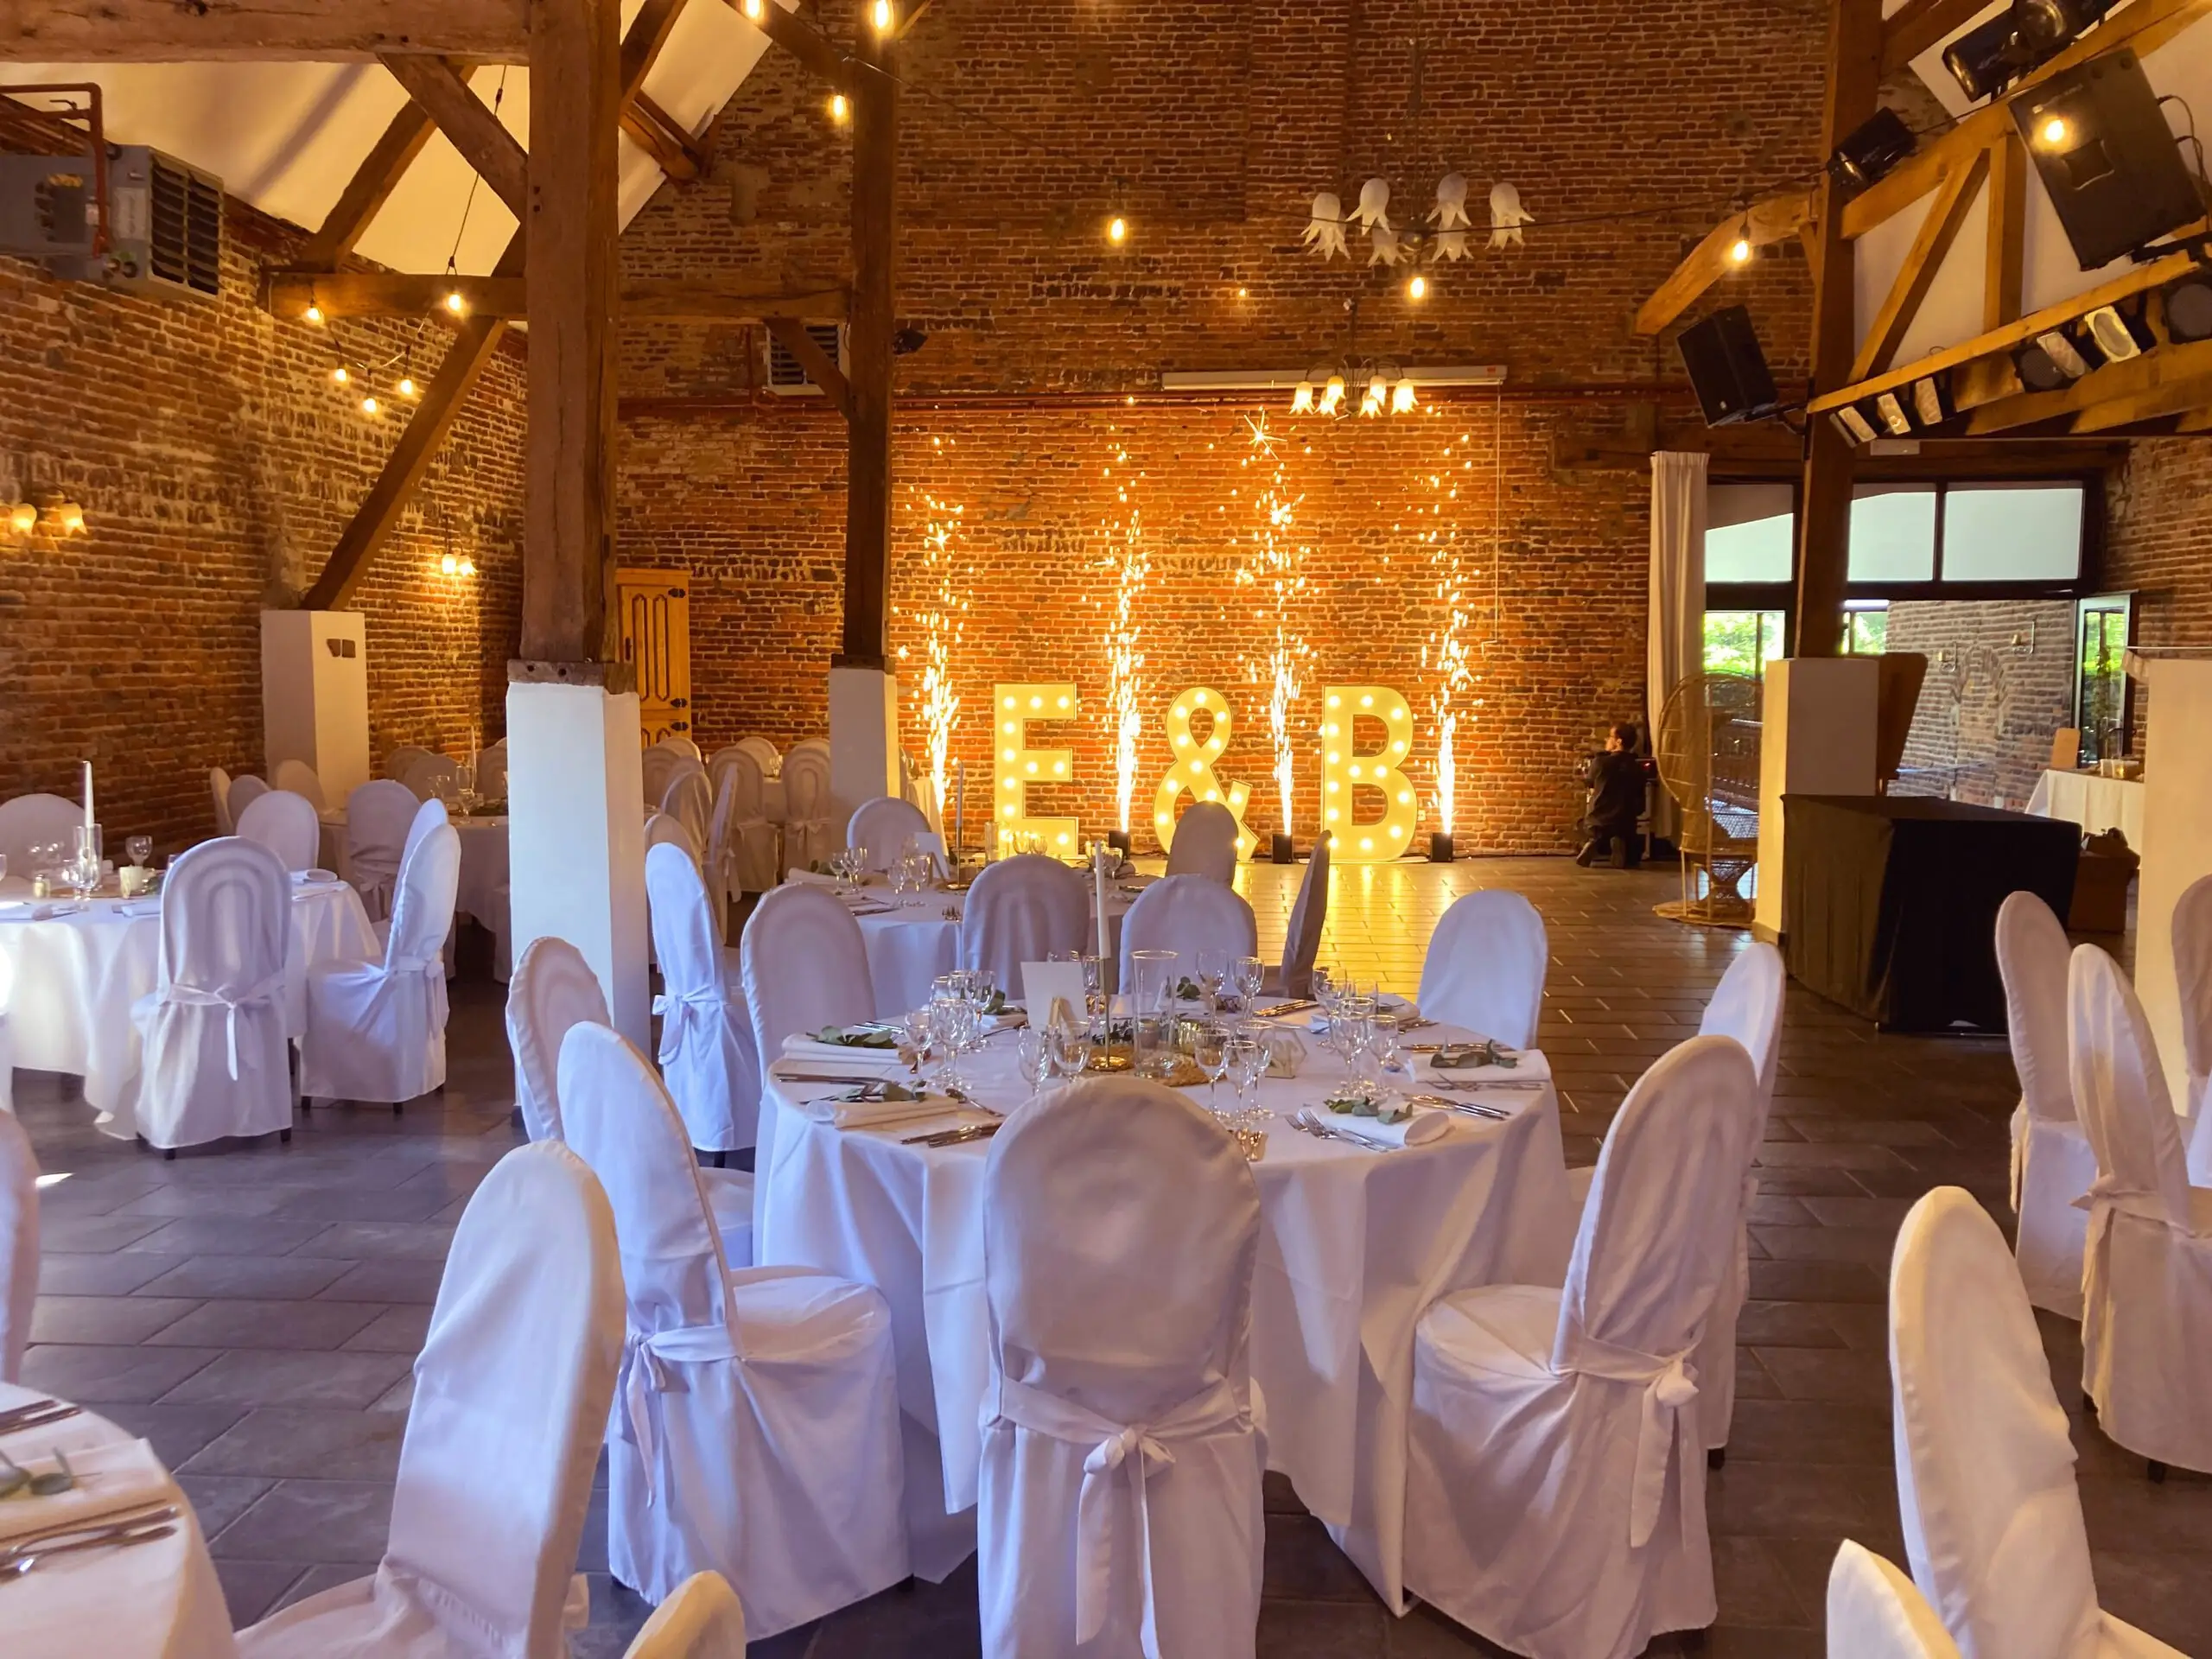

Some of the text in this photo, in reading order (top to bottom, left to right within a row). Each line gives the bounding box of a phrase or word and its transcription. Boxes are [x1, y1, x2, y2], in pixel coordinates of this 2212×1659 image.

[994, 683, 1418, 862] E & B
